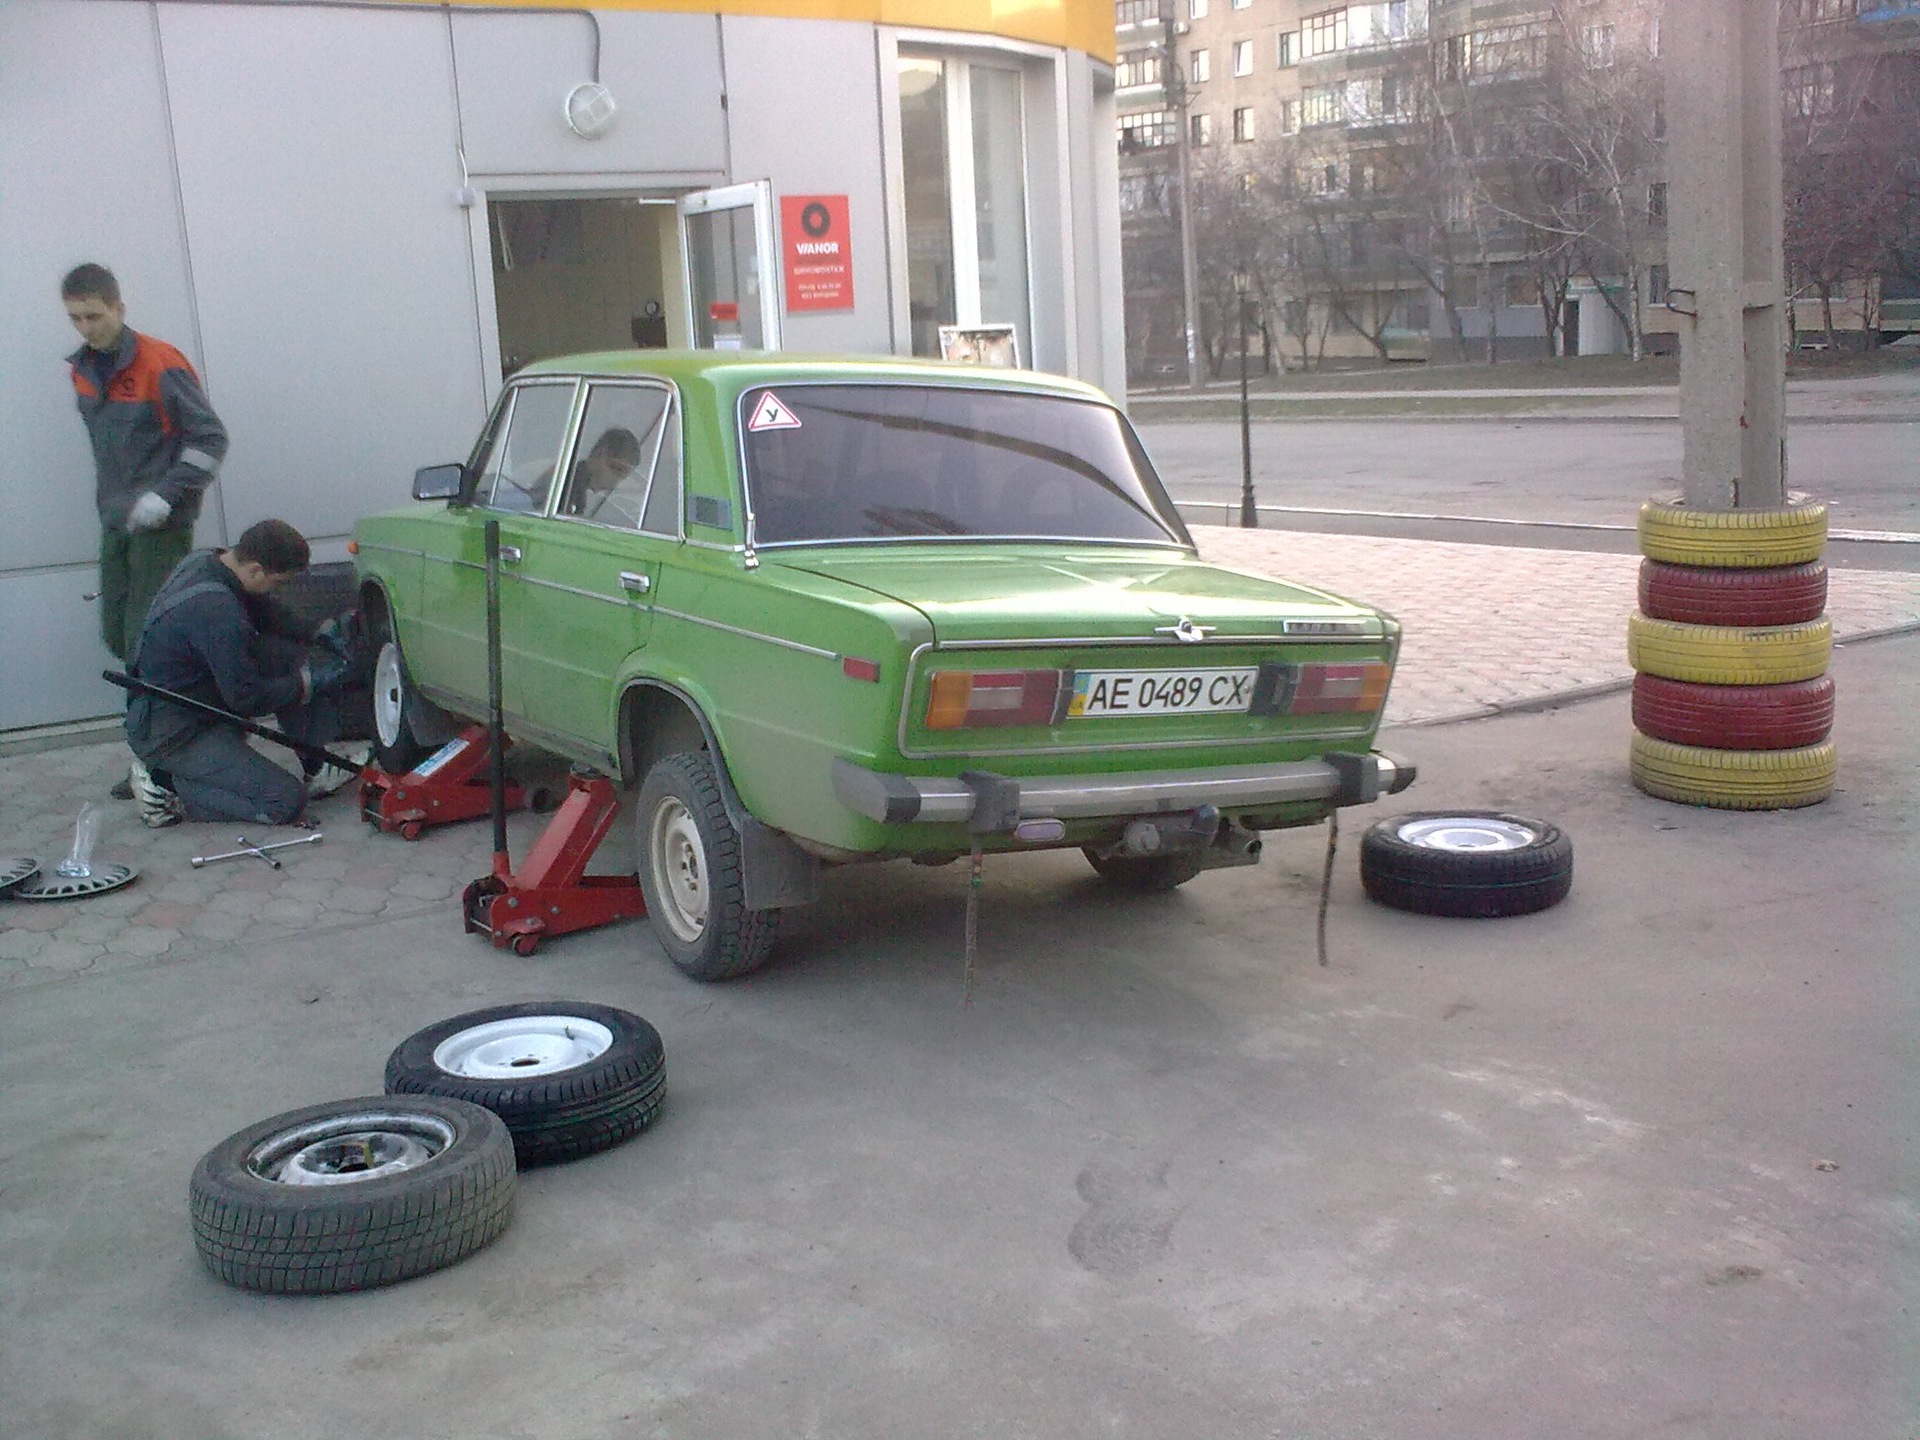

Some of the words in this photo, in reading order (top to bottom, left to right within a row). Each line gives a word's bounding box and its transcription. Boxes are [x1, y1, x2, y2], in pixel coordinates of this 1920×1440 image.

[796, 242, 839, 255] VIANOR
[1088, 678, 1133, 710] AE
[1138, 677, 1203, 708] 0489
[1208, 675, 1249, 706] CX
